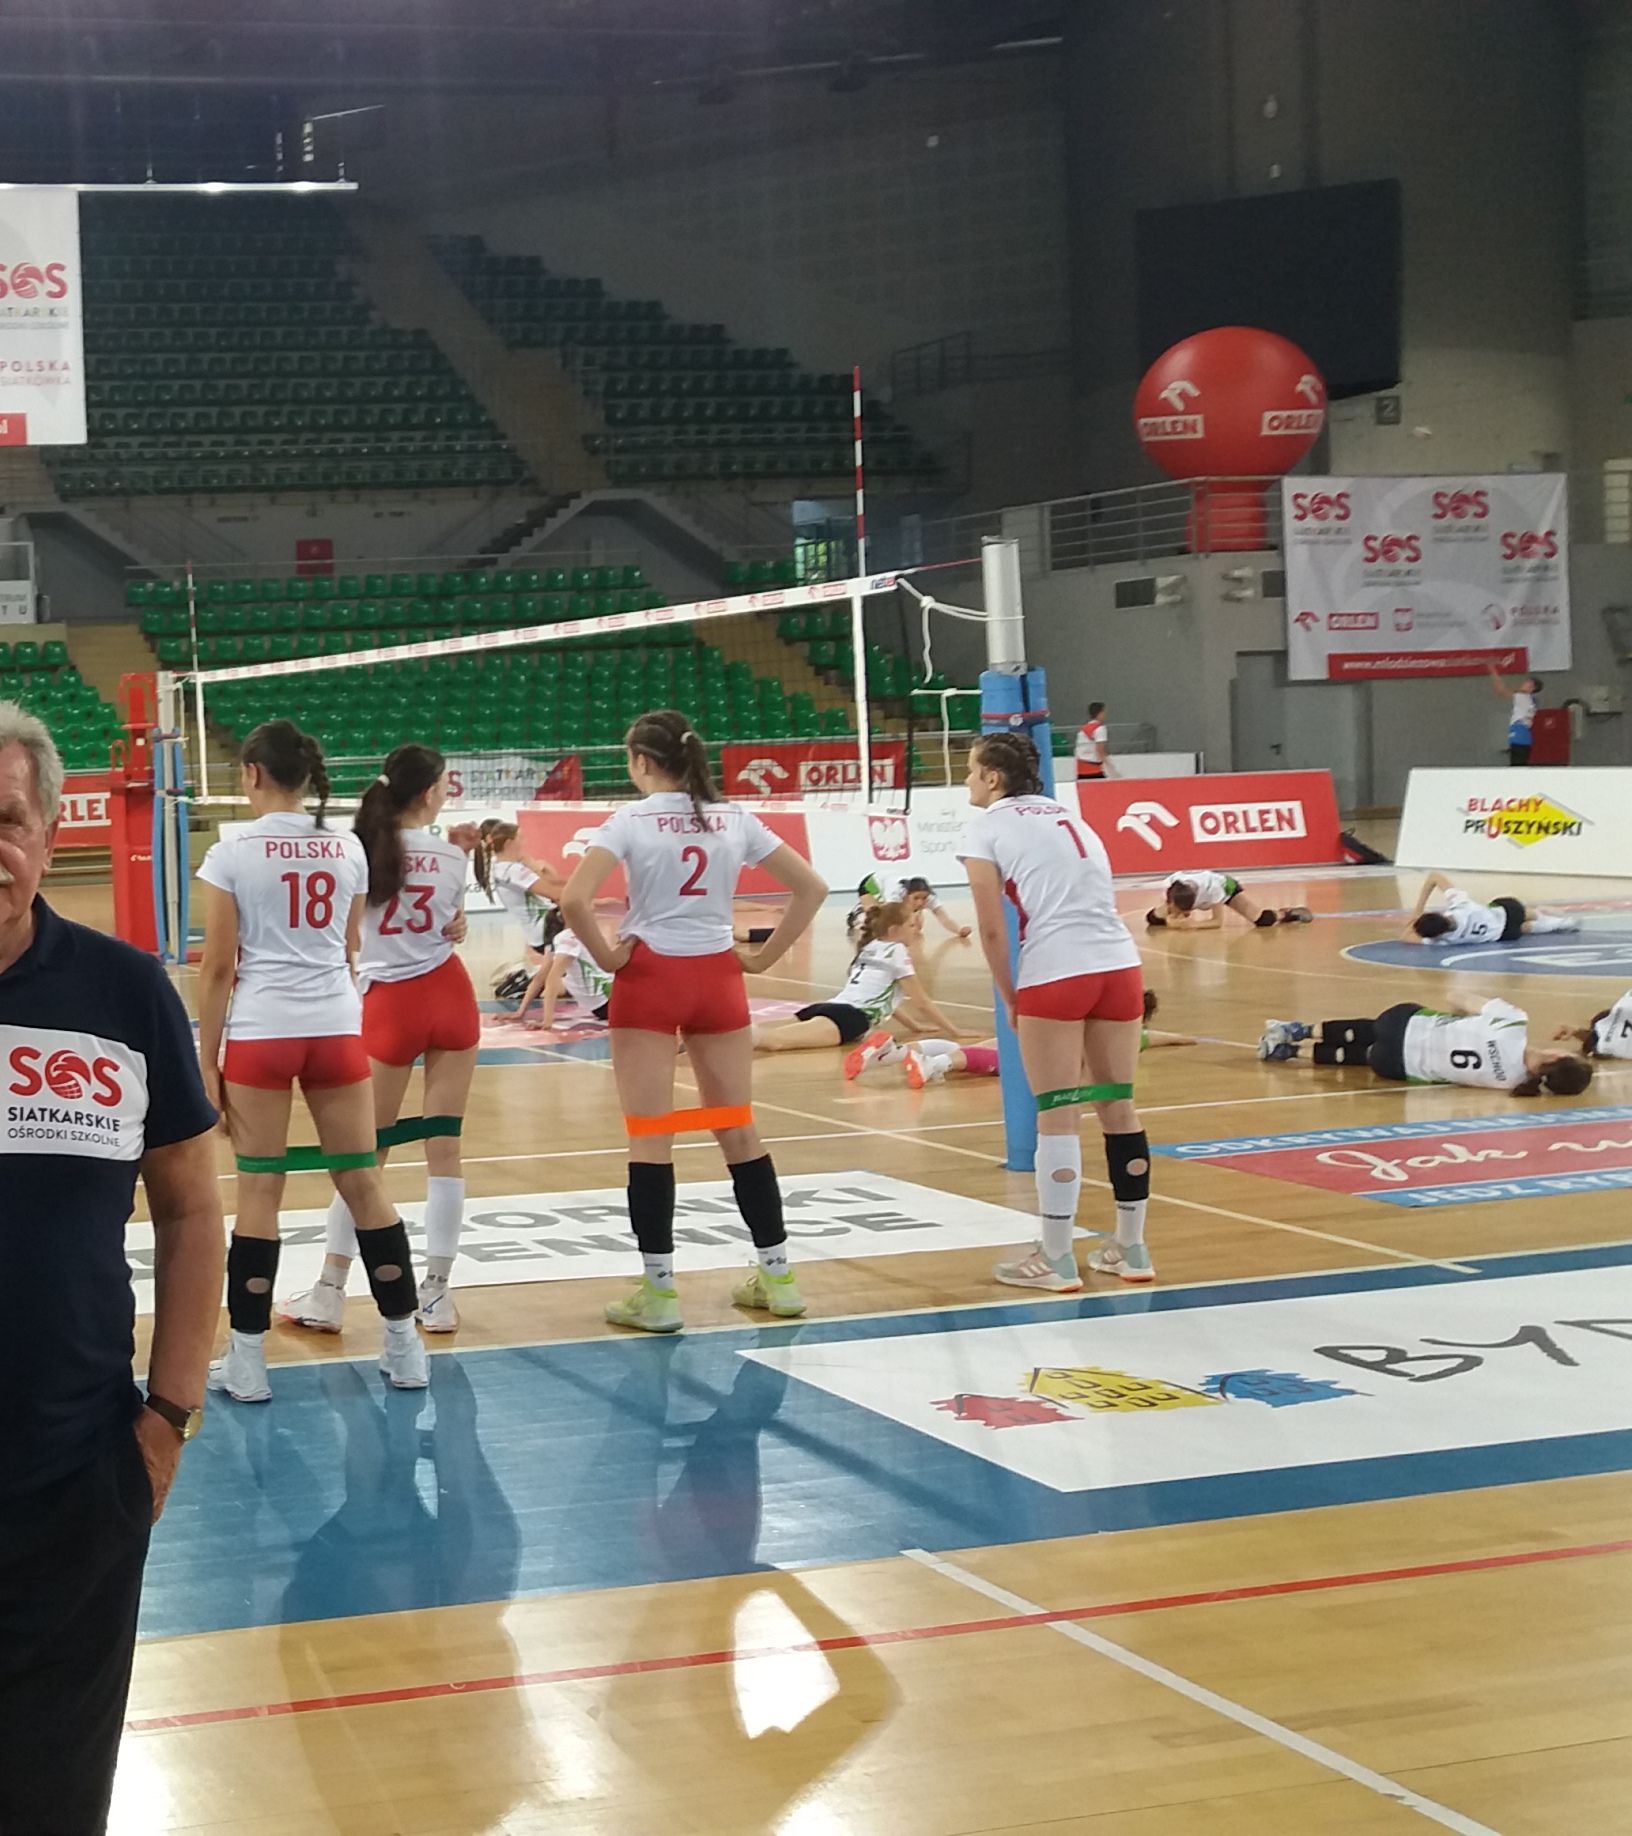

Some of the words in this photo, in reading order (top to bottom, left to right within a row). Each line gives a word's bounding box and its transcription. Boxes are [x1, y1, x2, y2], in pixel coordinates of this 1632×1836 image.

[0, 360, 72, 372] POLSKA
[1292, 491, 1352, 521] SOS
[1431, 489, 1490, 520] SOS
[1362, 534, 1422, 563] SOS
[805, 763, 888, 785] ORLN
[59, 799, 112, 822] RLE
[1467, 796, 1545, 814] BLACHY
[657, 815, 728, 835] POLSKA
[1199, 806, 1298, 837] ORLEN
[1462, 816, 1583, 839] PRUSZYŃSKI
[264, 840, 347, 860] POLSKA
[1056, 818, 1088, 860] 1
[678, 845, 710, 897] 2
[280, 870, 337, 930] 18
[377, 884, 436, 936] 23
[8, 1045, 123, 1108] SOS
[7, 1106, 121, 1133] SIATKARSKIE
[7, 1125, 69, 1141] OŚRODKI
[70, 1130, 121, 1148] SZKOLNE
[1315, 1142, 1529, 1183] Jak
[1408, 1181, 1540, 1205] JEDZ
